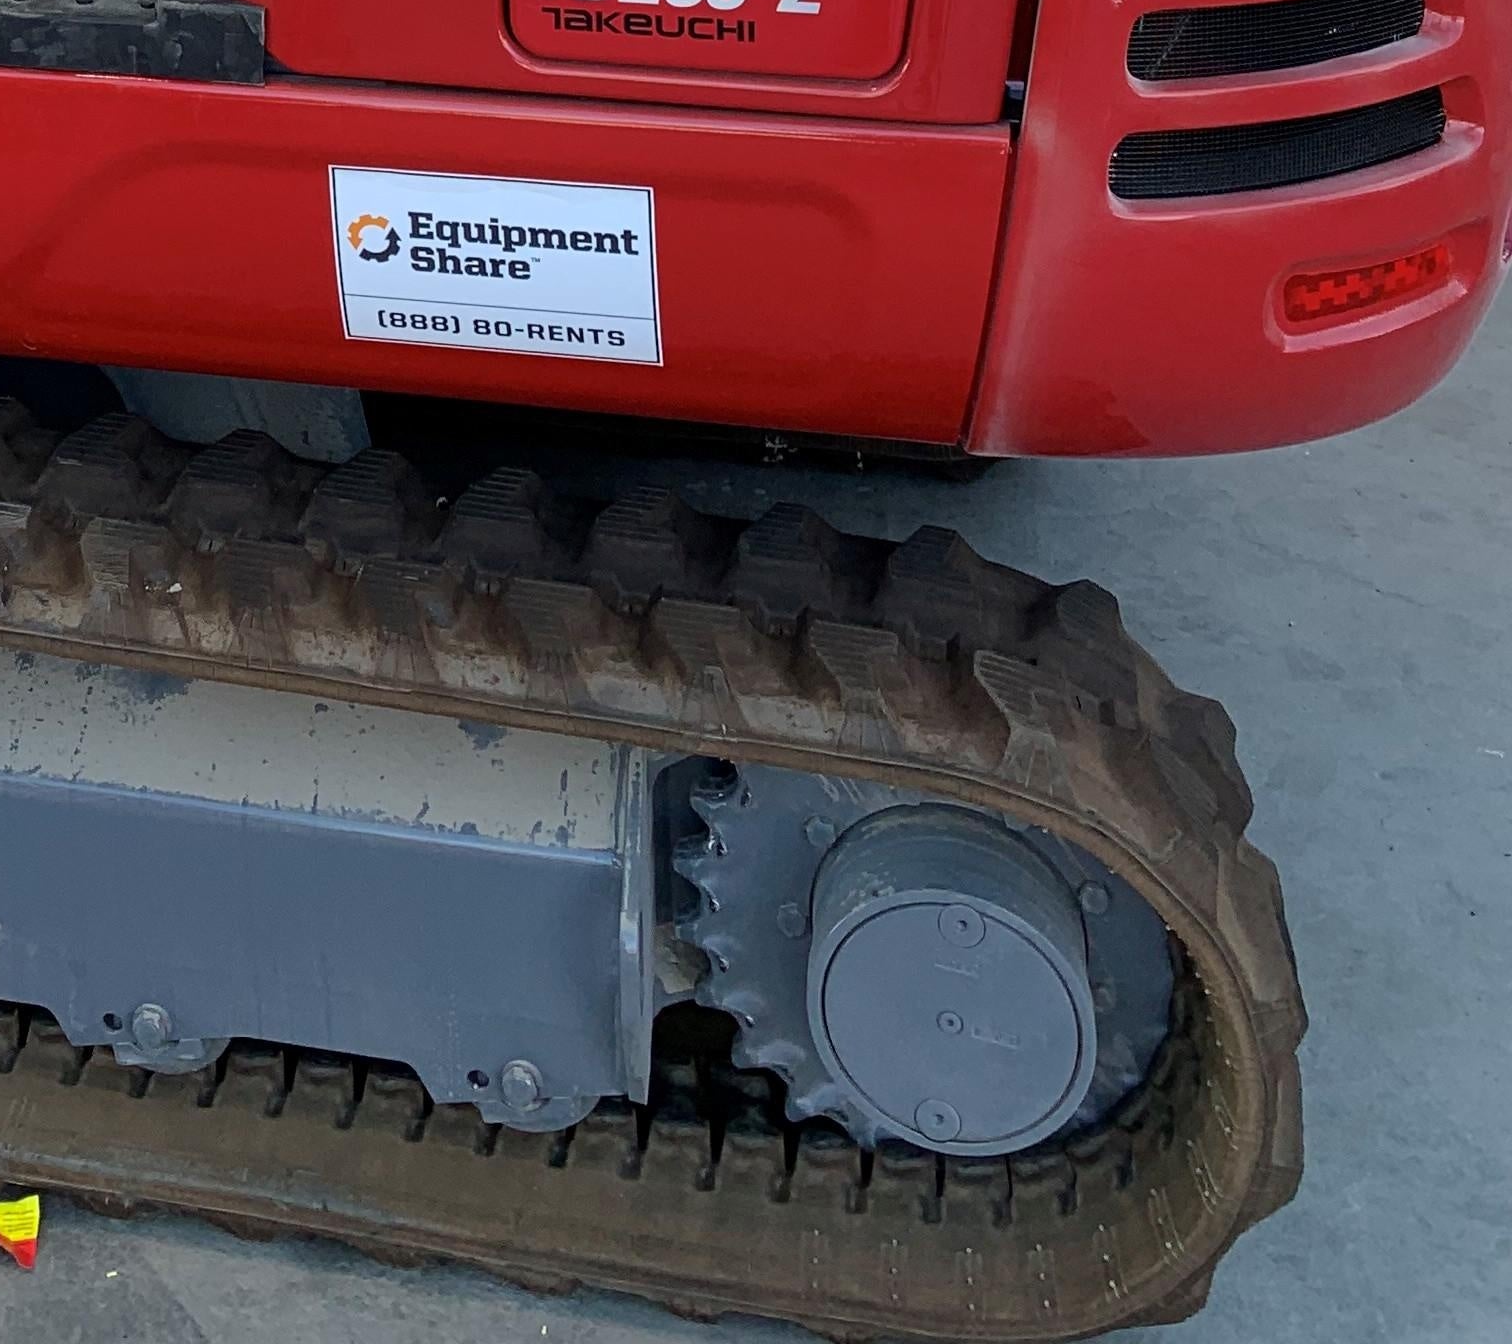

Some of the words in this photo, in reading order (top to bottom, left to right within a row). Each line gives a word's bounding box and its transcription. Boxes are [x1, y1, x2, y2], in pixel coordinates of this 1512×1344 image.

[541, 6, 757, 43] TAKEUCHI
[408, 211, 639, 256] Equipment
[377, 309, 461, 334] (888)
[473, 319, 627, 348] 80-RENTS
